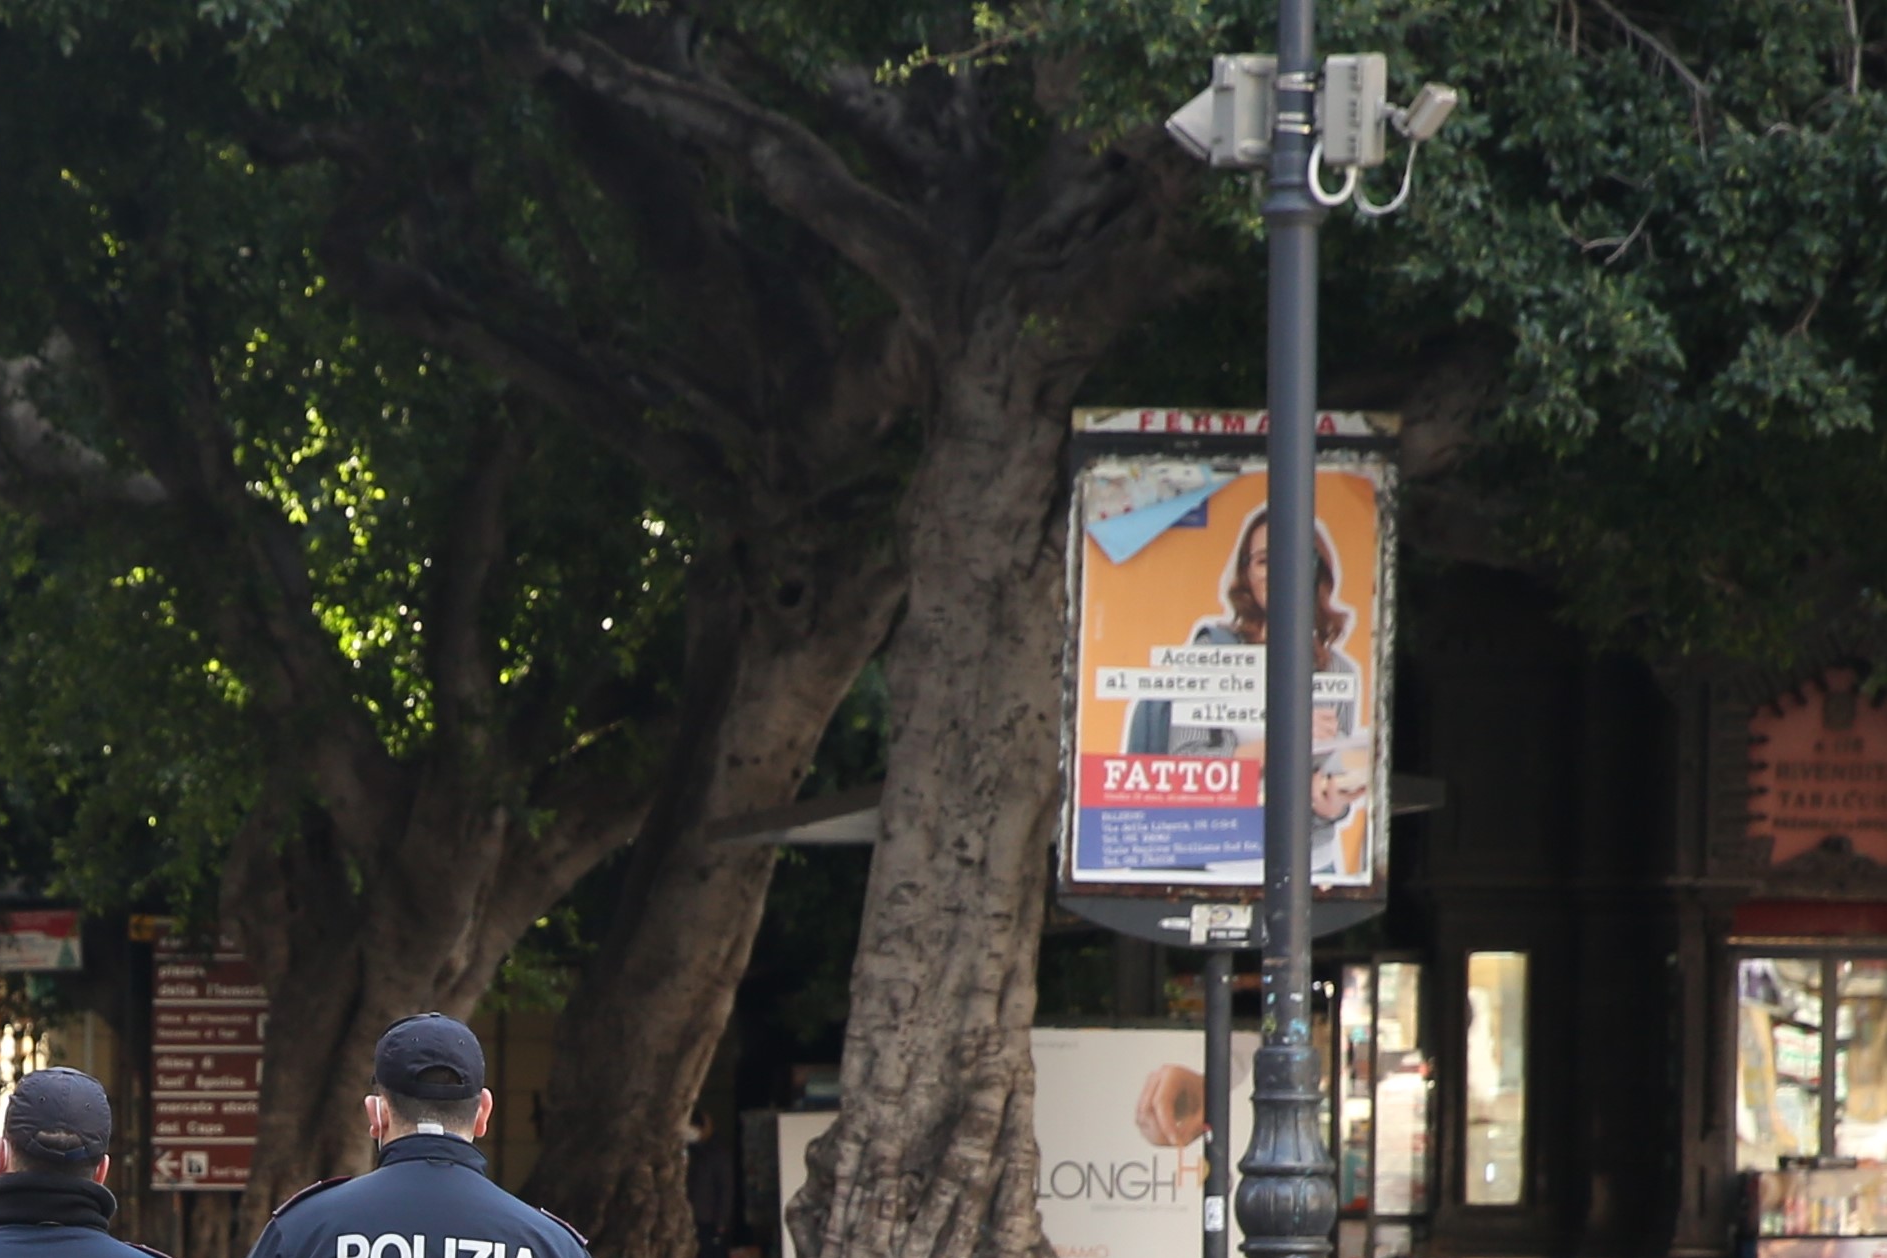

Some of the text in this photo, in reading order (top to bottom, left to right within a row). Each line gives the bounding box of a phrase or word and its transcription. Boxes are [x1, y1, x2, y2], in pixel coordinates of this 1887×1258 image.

[1139, 411, 1337, 434] FERMAA
[1161, 649, 1256, 667] Accedere
[1106, 672, 1127, 688] al
[1138, 676, 1209, 692] master
[1219, 675, 1254, 692] che
[1192, 704, 1267, 720] all'este
[1103, 759, 1241, 792] FATTO!
